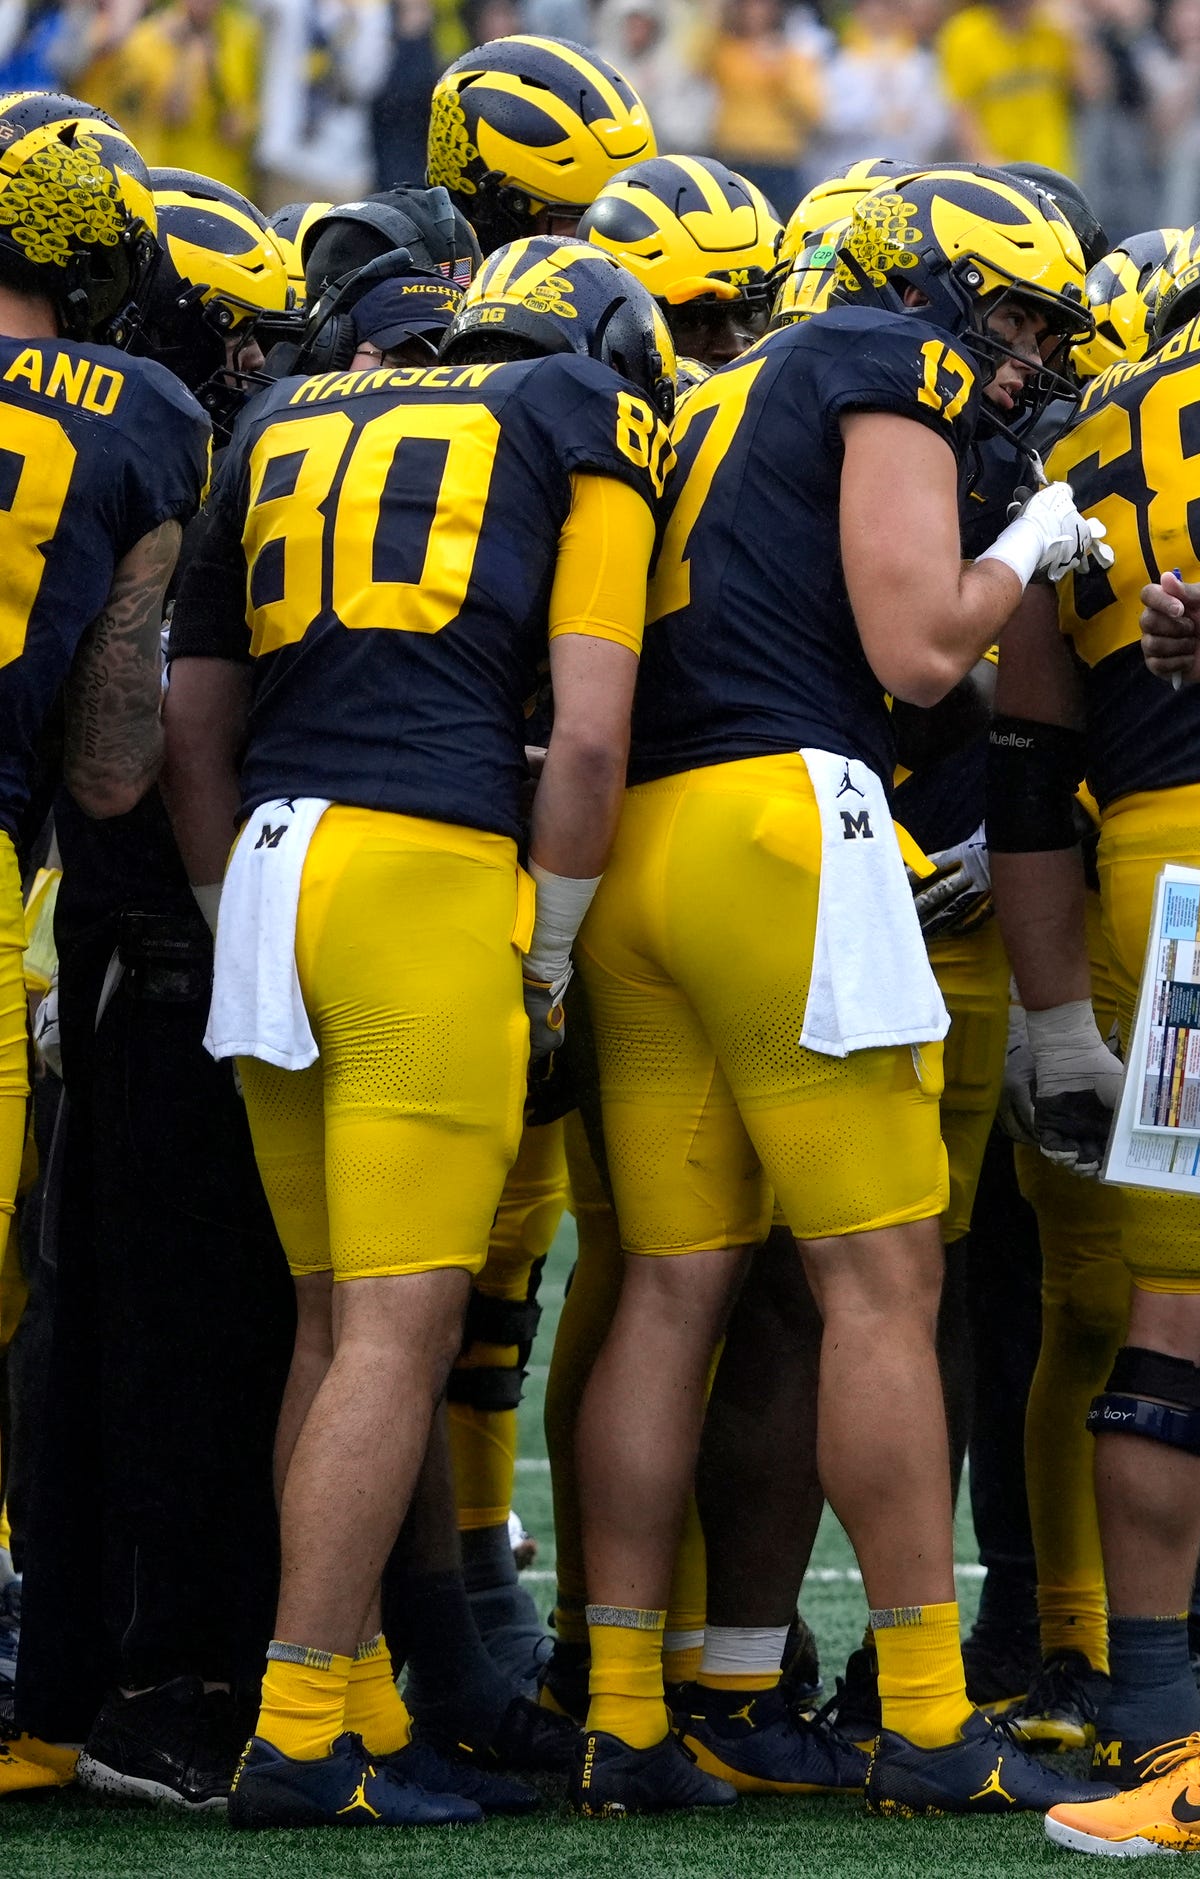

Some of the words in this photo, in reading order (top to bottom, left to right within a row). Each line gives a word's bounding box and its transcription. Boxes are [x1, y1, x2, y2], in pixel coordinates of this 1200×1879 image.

[813, 250, 833, 261] C2P
[728, 269, 750, 286] M
[288, 361, 508, 405] HANSEN
[917, 338, 976, 424] 17
[617, 391, 678, 499] 80
[241, 403, 502, 658] 80
[254, 824, 289, 850] M
[839, 810, 875, 840] M
[582, 1736, 597, 1789] GOBLUE
[1092, 1740, 1123, 1767] M
